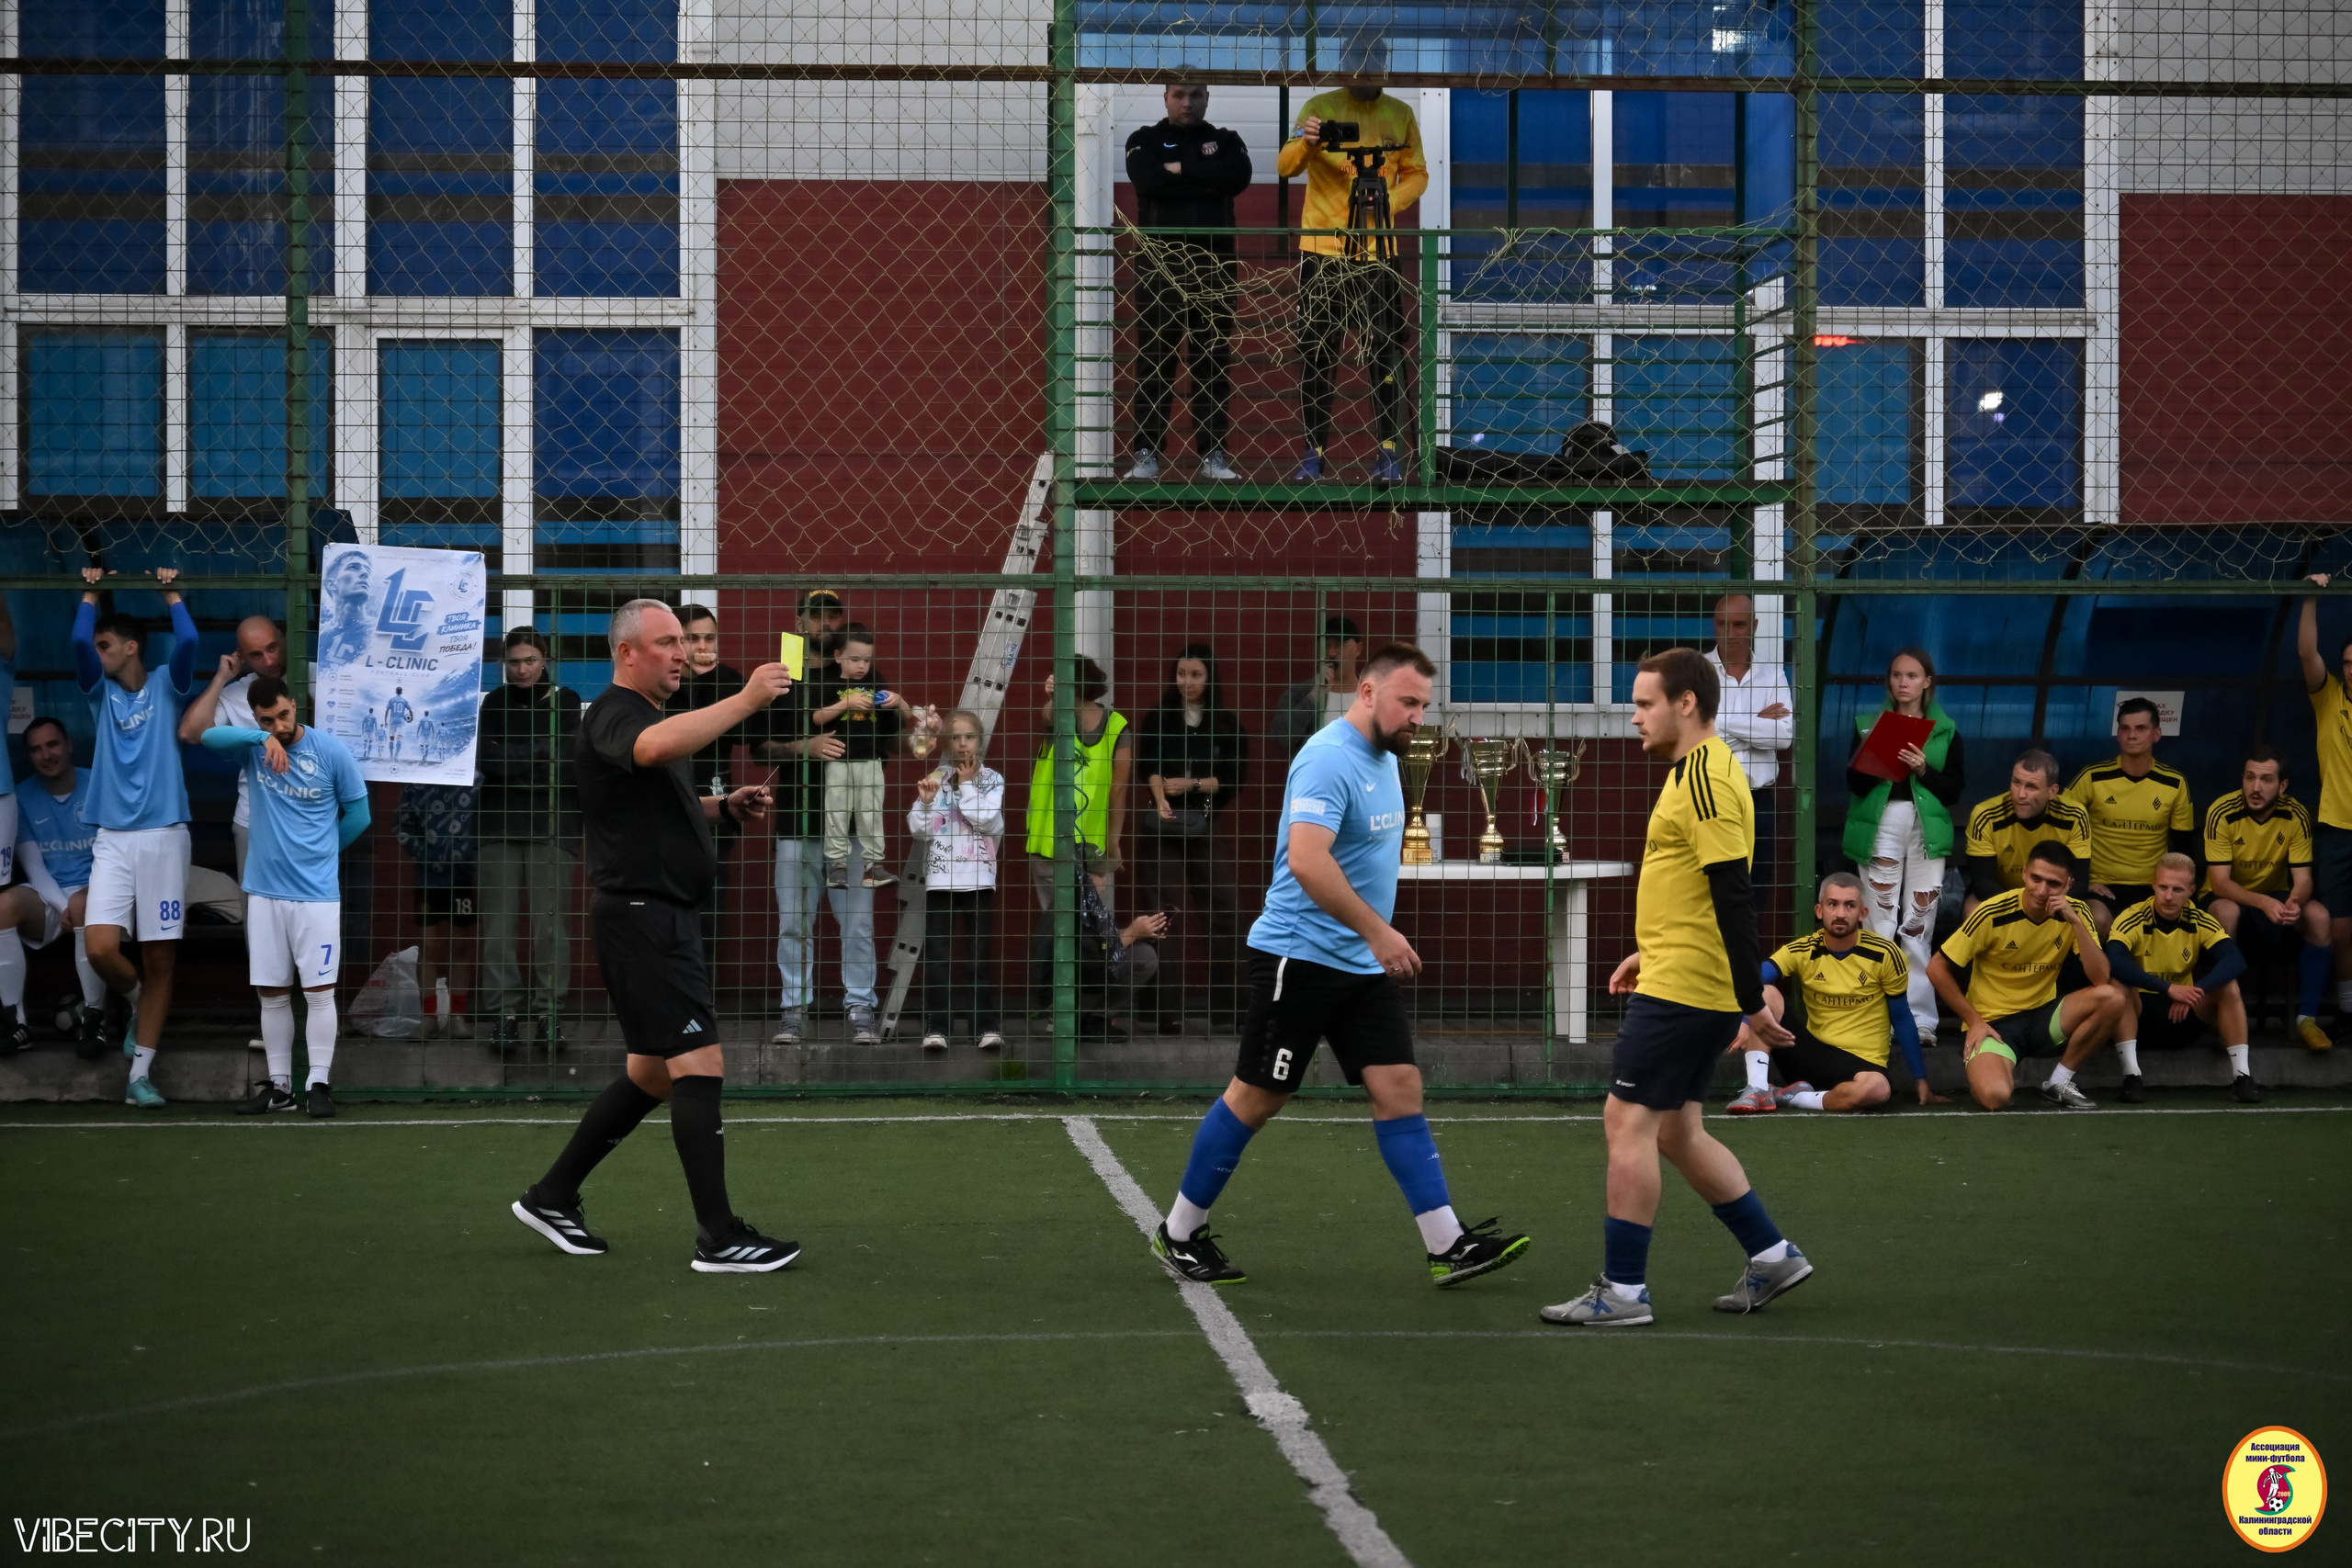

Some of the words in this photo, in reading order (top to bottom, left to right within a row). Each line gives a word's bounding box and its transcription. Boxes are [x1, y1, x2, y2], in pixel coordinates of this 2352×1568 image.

[447, 614, 467, 623] ТВОЯ
[441, 622, 476, 633] КЛИНИКА
[450, 635, 468, 643] ТВОЯ
[439, 642, 477, 654] ПОБЕДА!
[392, 702, 403, 714] 10
[1, 847, 11, 867] 19
[160, 900, 181, 921] 88
[455, 898, 471, 915] 18
[321, 944, 332, 965] 7
[1273, 1048, 1293, 1080] 6
